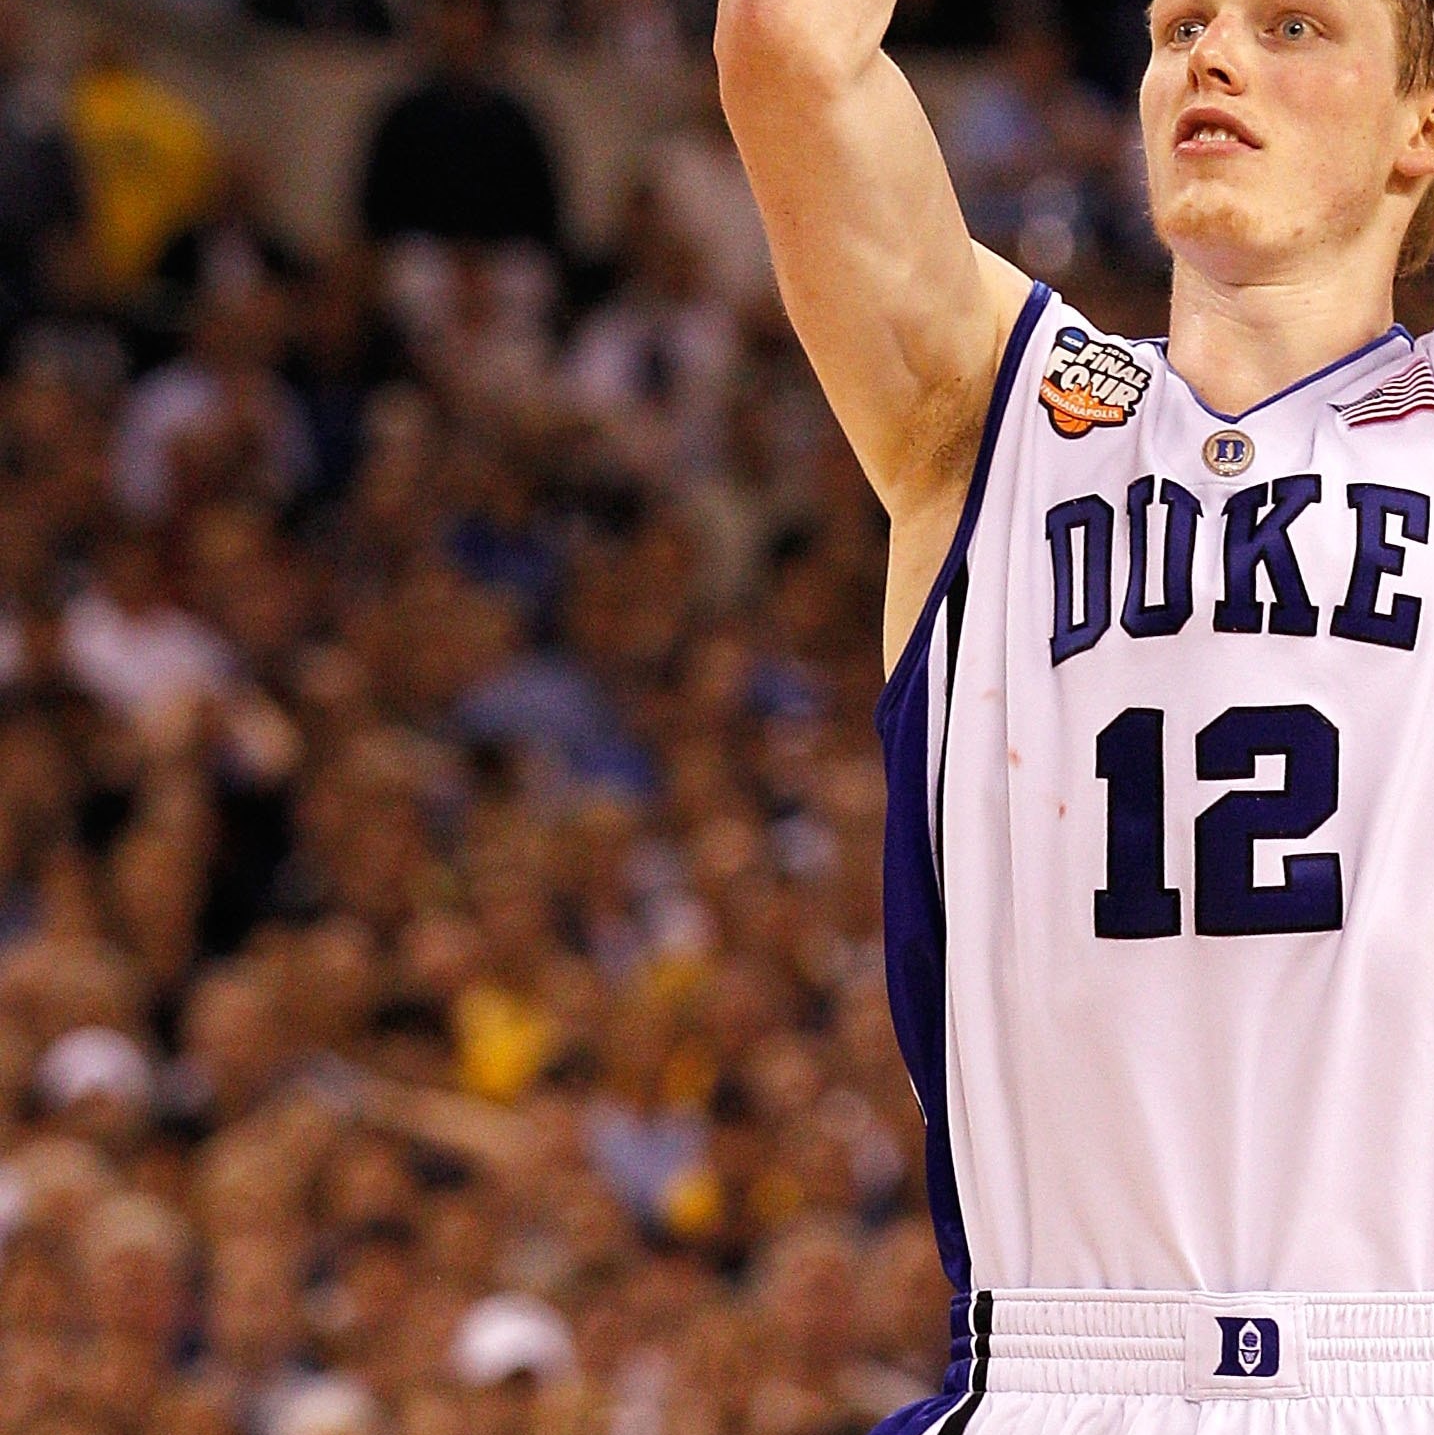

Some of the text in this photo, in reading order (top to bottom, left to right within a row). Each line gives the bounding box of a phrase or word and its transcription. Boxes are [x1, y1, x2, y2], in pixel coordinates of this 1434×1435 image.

[1045, 346, 1140, 412] FOUR
[1075, 343, 1148, 389] FINAL
[1040, 383, 1120, 419] INDIANAPOLIS
[1045, 474, 1431, 668] DUKE
[1094, 704, 1343, 940] 12
